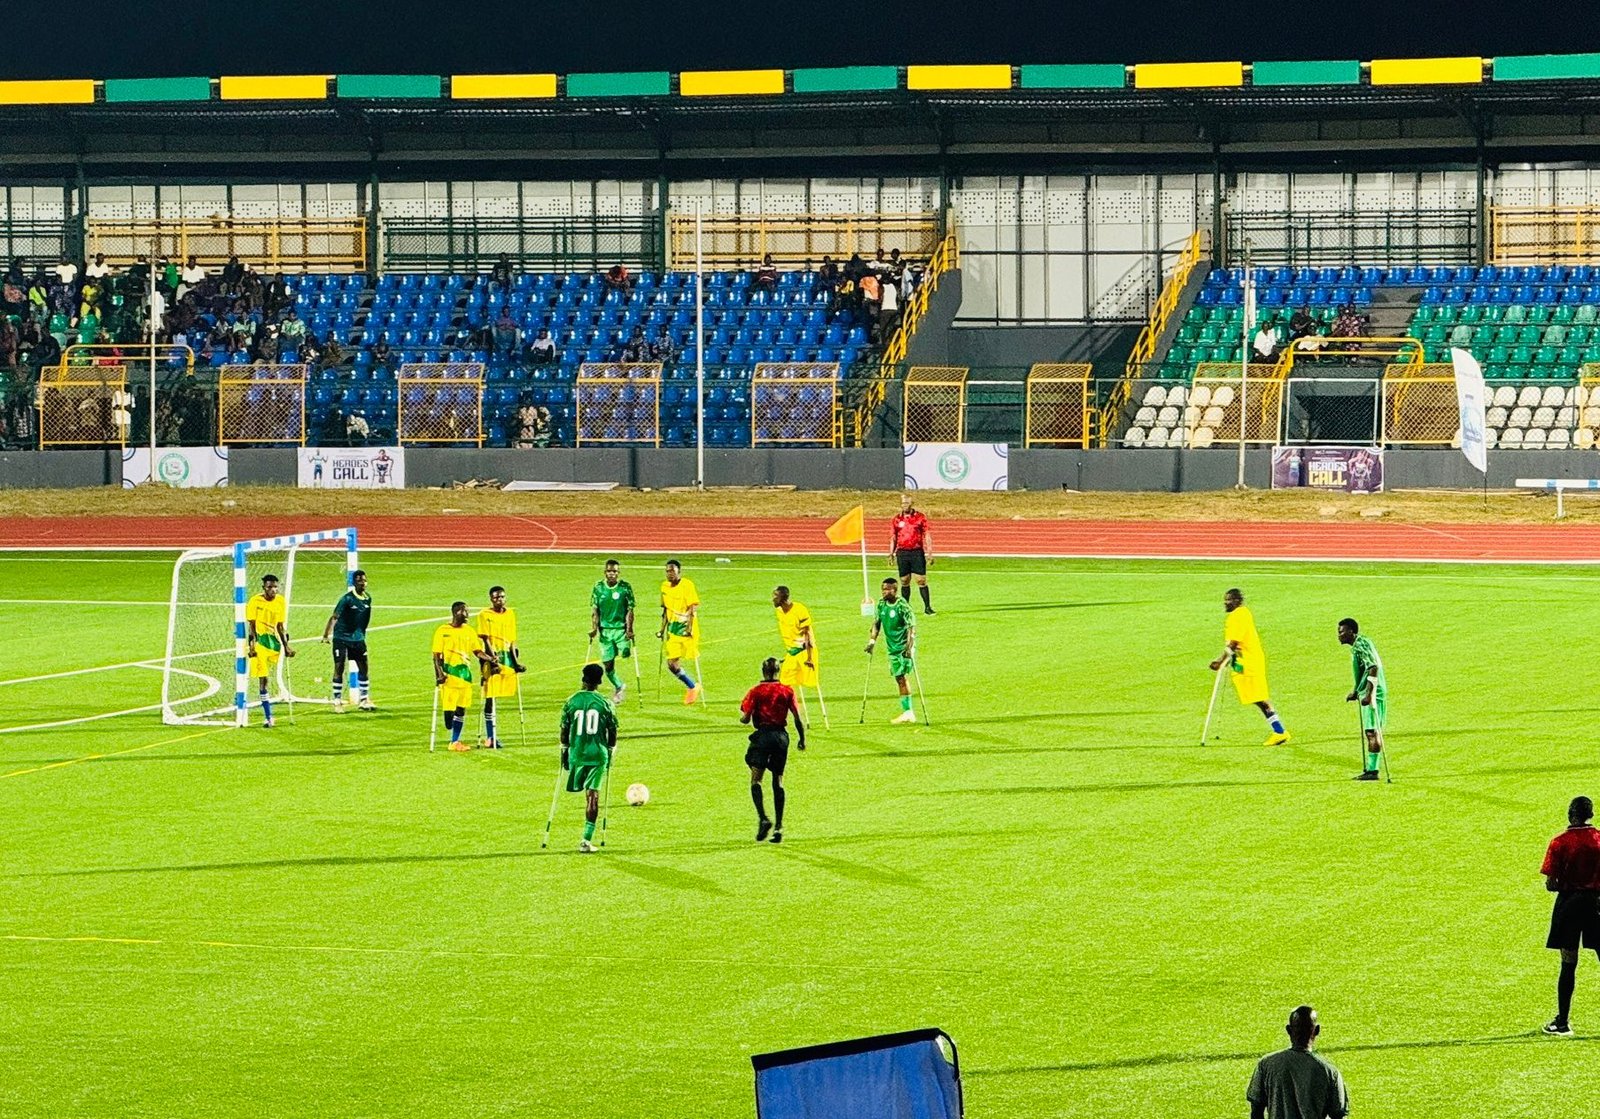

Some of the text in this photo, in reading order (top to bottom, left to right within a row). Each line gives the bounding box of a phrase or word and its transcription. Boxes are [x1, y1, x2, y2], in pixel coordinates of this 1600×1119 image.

[333, 459, 369, 468] HEROES
[1308, 461, 1347, 471] HEROES
[333, 468, 368, 480] CALL
[1308, 471, 1347, 485] CALL
[574, 709, 599, 736] 10
